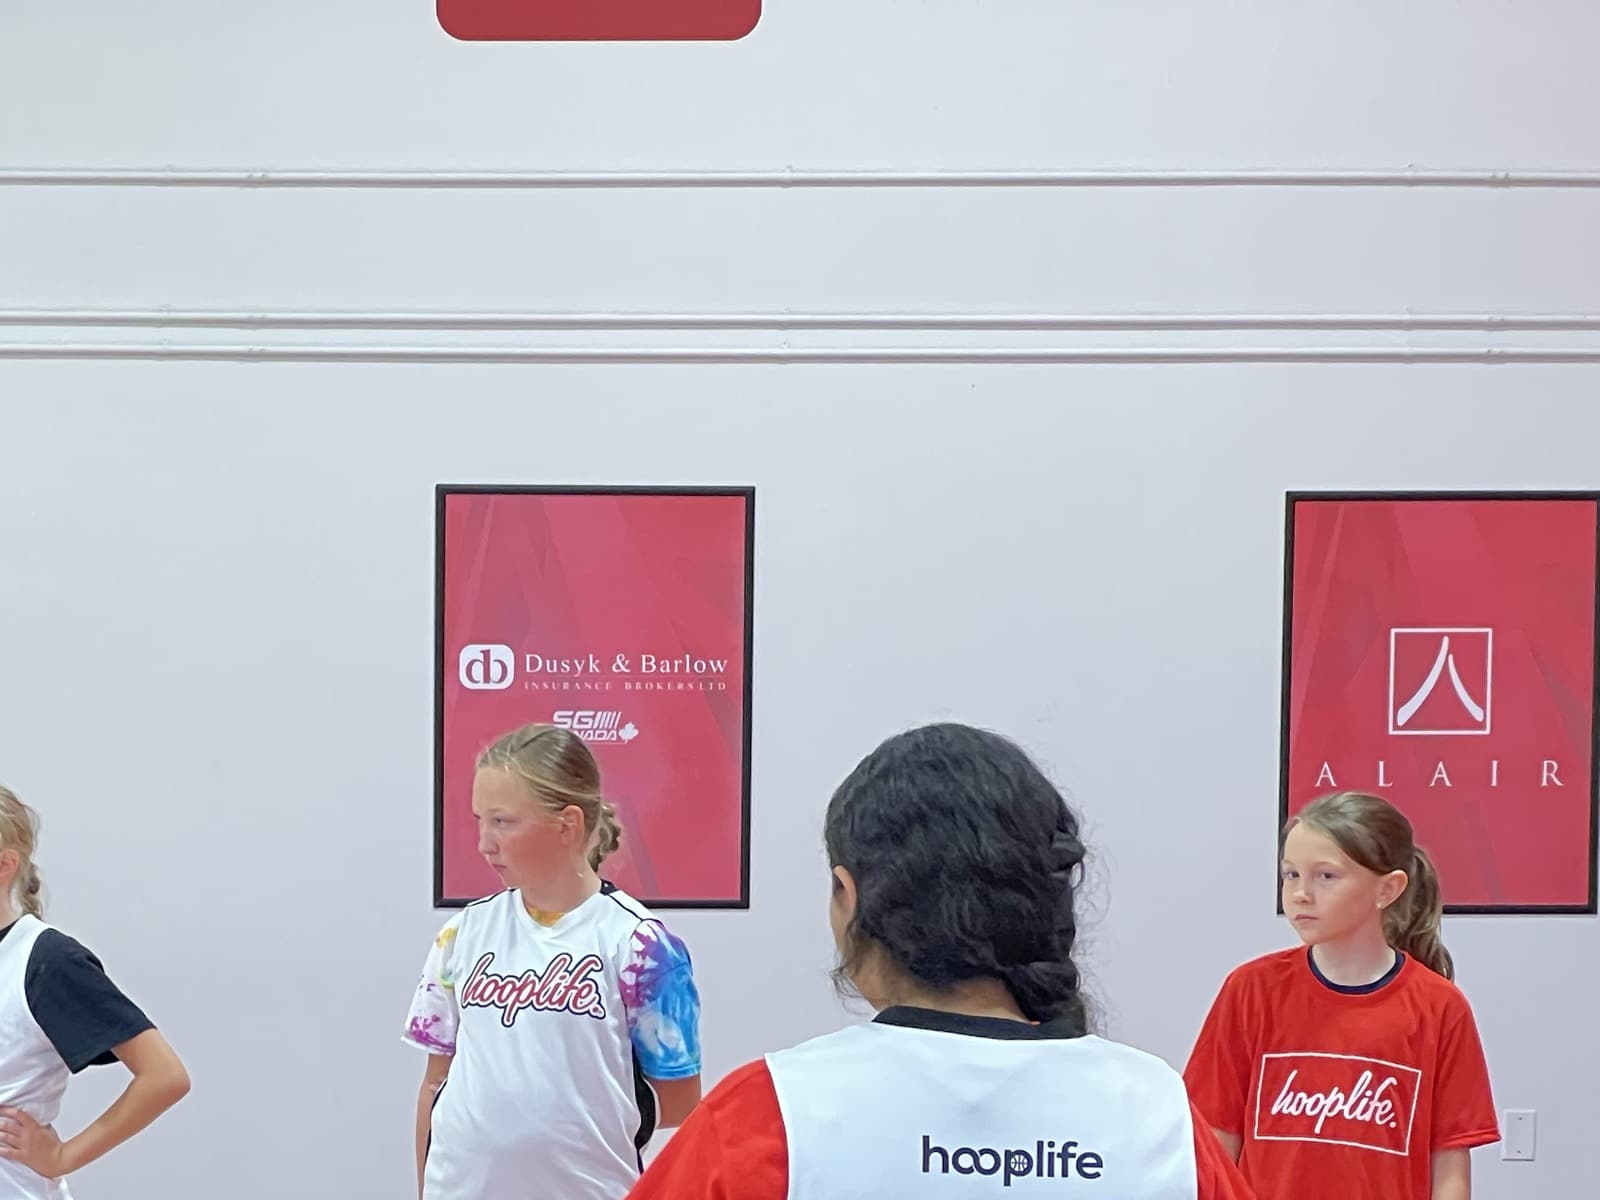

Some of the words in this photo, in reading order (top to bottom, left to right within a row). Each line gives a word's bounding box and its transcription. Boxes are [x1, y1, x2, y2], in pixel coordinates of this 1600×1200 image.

[525, 653, 600, 677] Dusyk
[612, 653, 631, 673] &
[641, 653, 728, 673] Barlow
[524, 681, 612, 691] INSURANCE
[572, 729, 617, 741] NADA
[1314, 760, 1565, 787] ALAIR
[461, 951, 606, 1028] hooplife.
[1271, 1069, 1398, 1135] hooplife.
[922, 1135, 1104, 1187] hooplife
